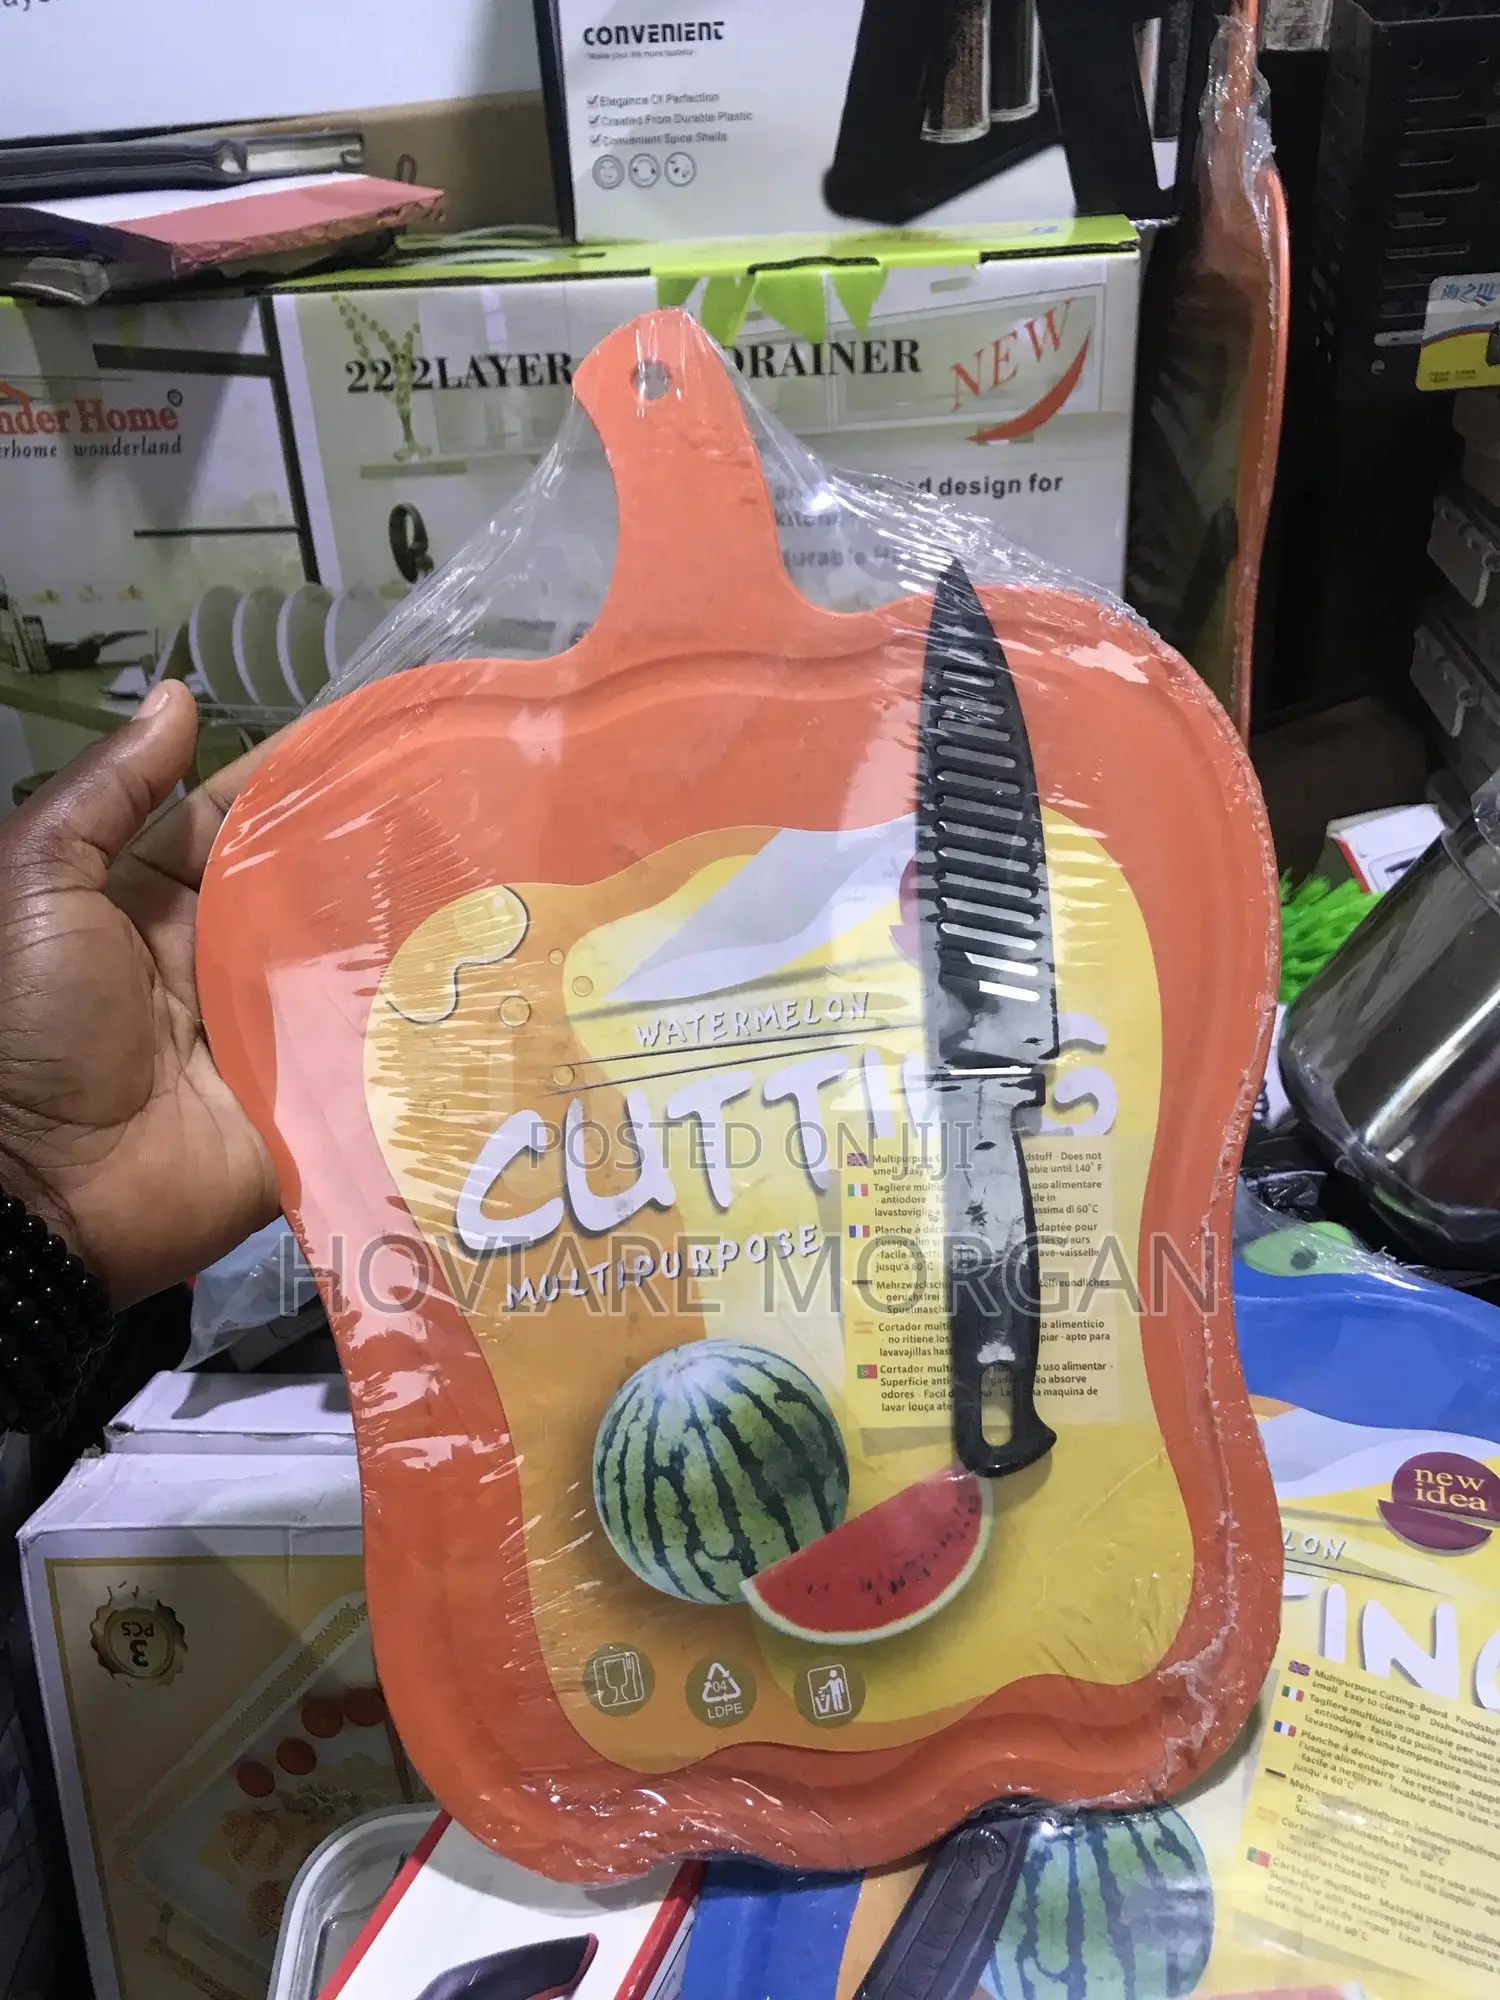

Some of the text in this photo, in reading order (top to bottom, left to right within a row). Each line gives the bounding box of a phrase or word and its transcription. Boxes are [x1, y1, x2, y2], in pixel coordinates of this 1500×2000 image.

[583, 21, 725, 46] CONVENIENT
[951, 299, 1073, 411] NEW
[75, 396, 179, 433] Home
[0, 434, 183, 460] rhome wonderland
[939, 476, 1021, 499] design
[1029, 472, 1063, 493] for
[636, 991, 869, 1048] WATERMELON
[455, 1012, 1118, 1254] CUTTIG
[873, 1155, 933, 1164] Multipurpose
[1025, 1152, 1052, 1160] dstuff
[1061, 1152, 1083, 1160] Does
[873, 1167, 897, 1175] smell
[904, 1167, 923, 1176] Easy
[1051, 1164, 1072, 1172] until
[874, 1183, 911, 1193] Tagliere
[1051, 1180, 1102, 1189] alimentare
[881, 1195, 926, 1204] antiodore
[1047, 1193, 1056, 1201] in
[1066, 1205, 1075, 1213] di
[875, 1226, 912, 1234] Planche
[1075, 1224, 1098, 1232] pour
[505, 1224, 822, 1310] MULTIPURPOSE
[878, 1323, 921, 1331] Cortador
[1050, 1319, 1104, 1328] alimenticio
[903, 1334, 934, 1343] ritiene
[1041, 1333, 1058, 1343] piar
[1066, 1333, 1086, 1342] apto
[1090, 1333, 1110, 1342] para
[880, 1346, 952, 1358] lavavajillas hast
[880, 1365, 924, 1373] Cortador
[1044, 1363, 1060, 1371] uso
[1062, 1361, 1106, 1370] alimentar
[880, 1377, 929, 1387] Superficie
[1048, 1375, 1086, 1383] absorve
[881, 1387, 1098, 1399] odores Facil maquina de
[882, 1403, 905, 1411] lavar
[908, 1402, 934, 1412] louça
[1414, 1467, 1486, 1492] new
[1415, 1481, 1489, 1512] idea
[120, 1620, 155, 1638] PCS
[128, 1638, 150, 1668] 3
[711, 1680, 728, 1693] 04
[1314, 1669, 1377, 1695] Multipurpose
[1420, 1703, 1448, 1719] Board
[1310, 1693, 1348, 1712] Tagliere
[1312, 1681, 1338, 1694] smell
[1344, 1690, 1365, 1704] Easy
[1368, 1697, 1377, 1706] to
[1380, 1701, 1406, 1716] clean
[1408, 1711, 1421, 1722] up
[706, 1702, 744, 1720] LDPE
[1301, 1729, 1340, 1750] Planche
[1371, 1725, 1397, 1740] facile
